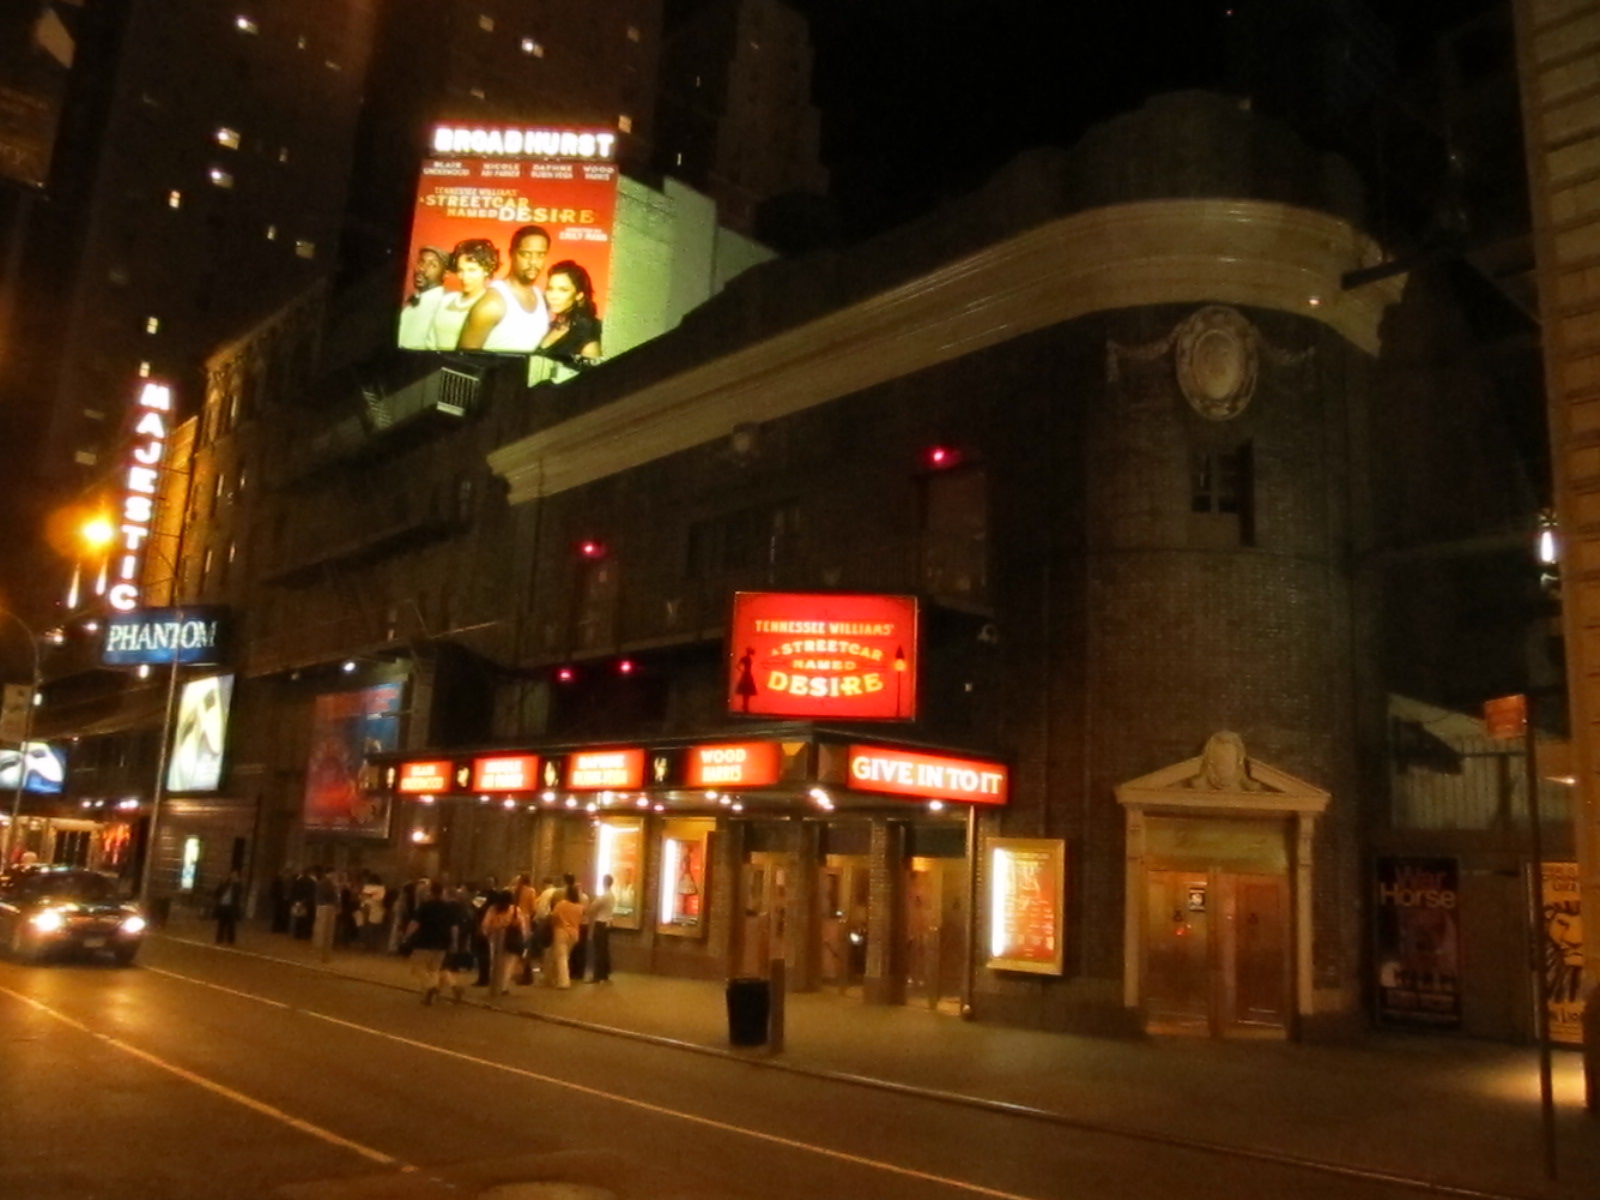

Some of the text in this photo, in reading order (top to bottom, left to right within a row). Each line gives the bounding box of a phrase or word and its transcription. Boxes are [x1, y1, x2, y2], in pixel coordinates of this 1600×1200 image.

[434, 128, 615, 157] BROADHURST
[426, 194, 529, 209] STREETCAR
[447, 207, 595, 223] NAMED DESIRE
[109, 383, 171, 611] MAJESTIC
[106, 620, 217, 653] PHANTOM
[755, 620, 825, 634] TENNESSEE
[781, 639, 884, 661] STREETCAR
[792, 659, 856, 670] NAMED
[767, 671, 884, 697] DESIRE
[700, 749, 747, 764] WOOD
[852, 756, 1003, 794] GIVE IN TO IT
[1379, 882, 1457, 909] Horse
